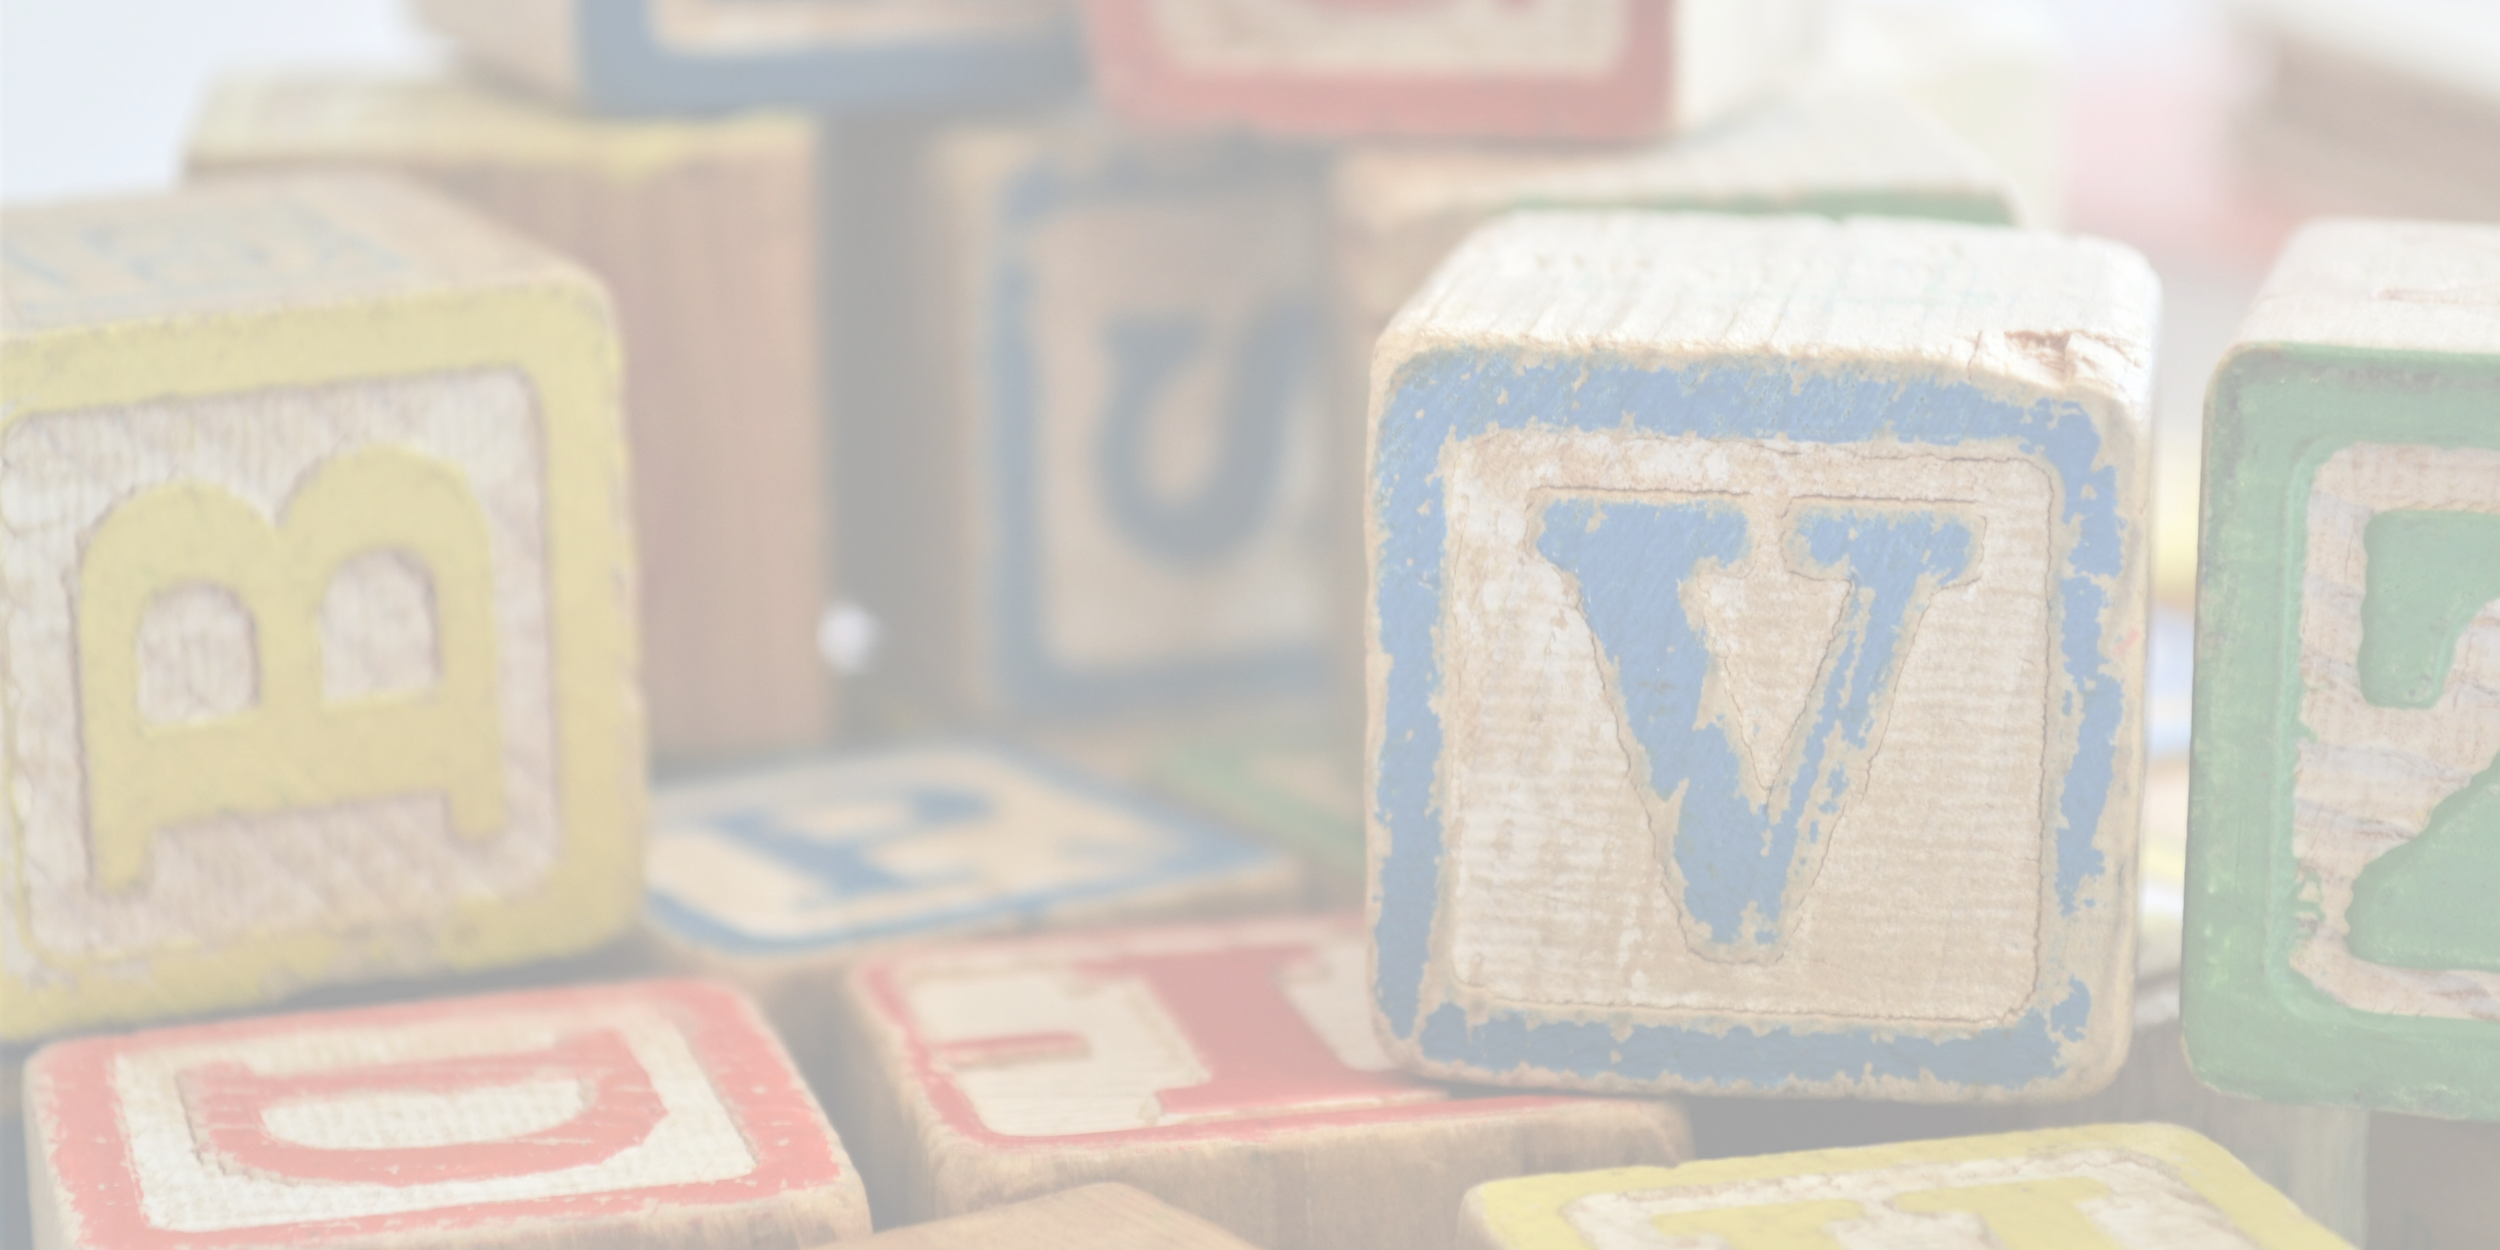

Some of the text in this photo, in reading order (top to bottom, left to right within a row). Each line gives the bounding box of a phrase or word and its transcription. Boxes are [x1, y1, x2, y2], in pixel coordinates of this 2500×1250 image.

[78, 444, 507, 893] B
[1528, 490, 1984, 958] V
[180, 1027, 668, 1188] D
